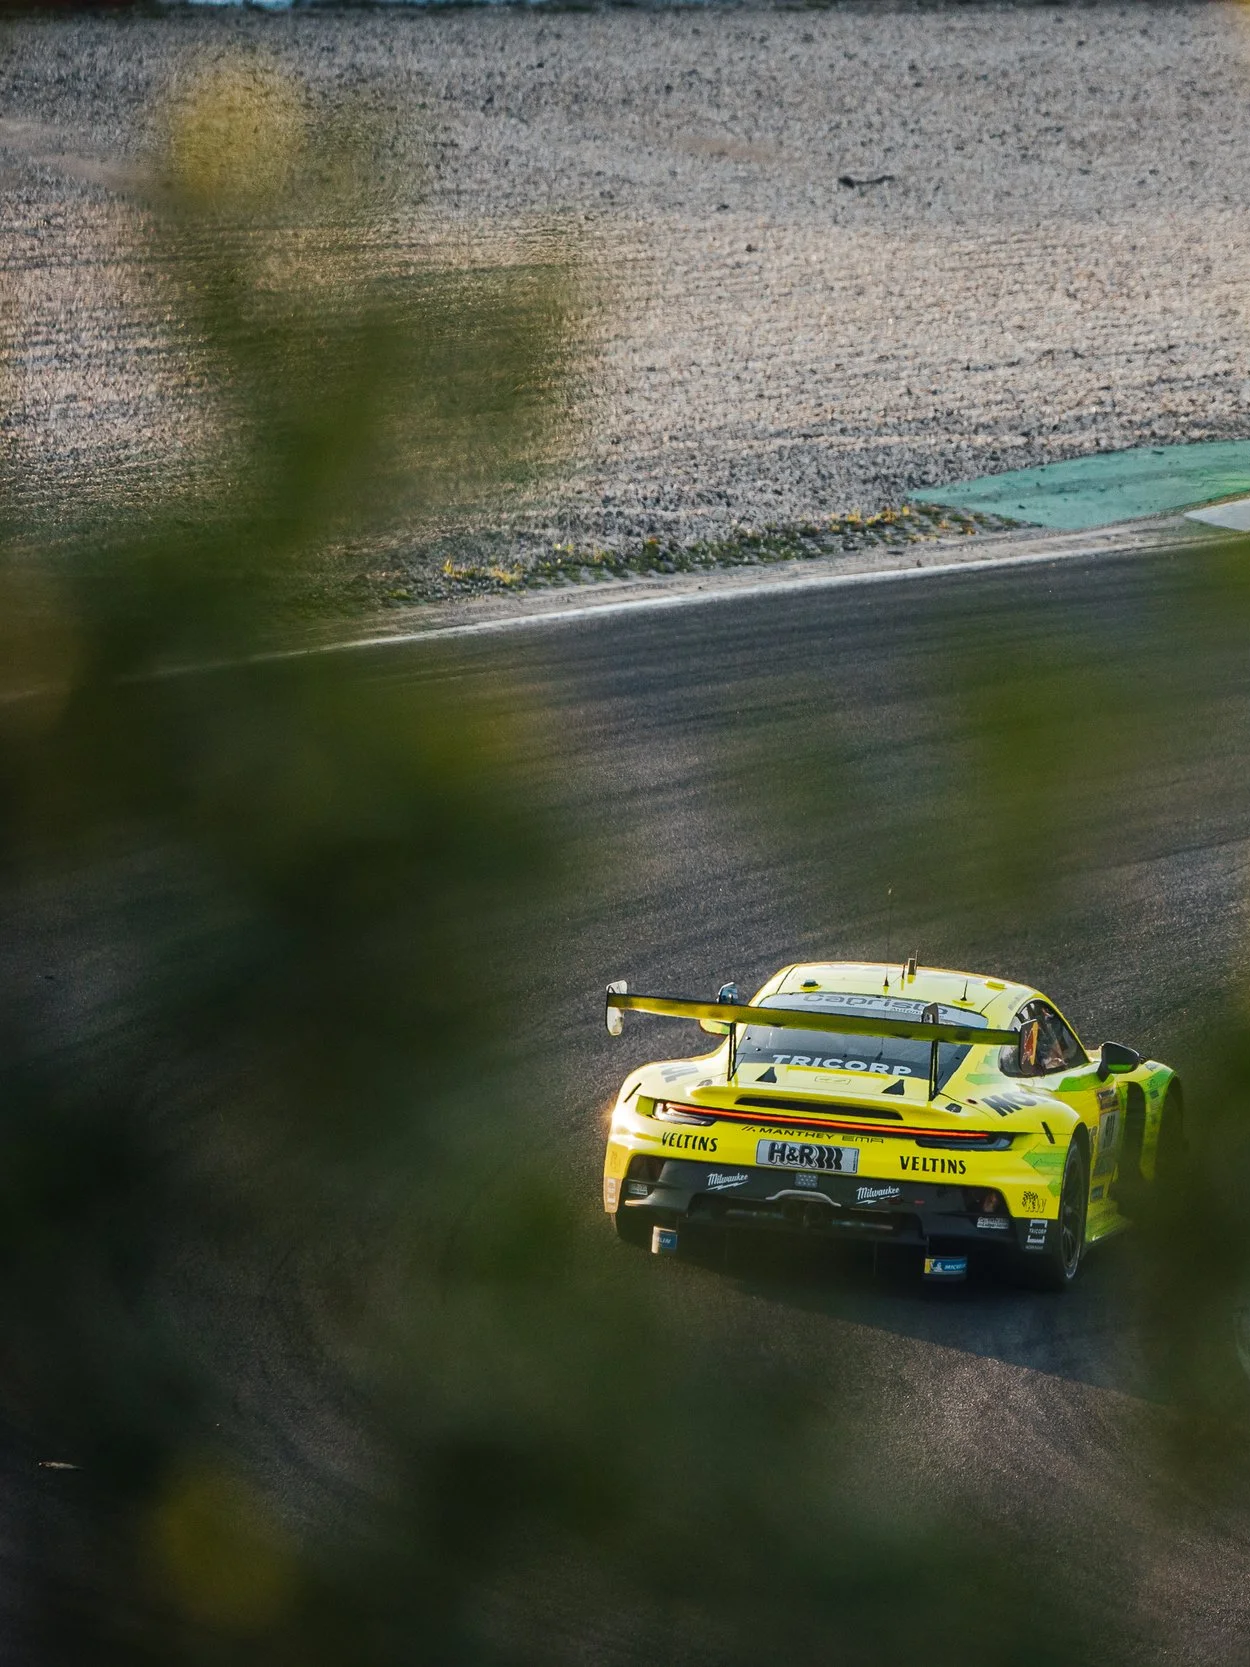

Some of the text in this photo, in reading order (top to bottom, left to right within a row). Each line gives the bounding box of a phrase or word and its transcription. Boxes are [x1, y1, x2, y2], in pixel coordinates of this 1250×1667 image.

[772, 1054, 912, 1076] TRICORP
[661, 1131, 718, 1152] VELTINS
[759, 1127, 884, 1144] MANTHEY EMA
[899, 1155, 967, 1175] VELTINS
[707, 1172, 748, 1187] Milwaukee
[856, 1185, 900, 1200] Milwaukee
